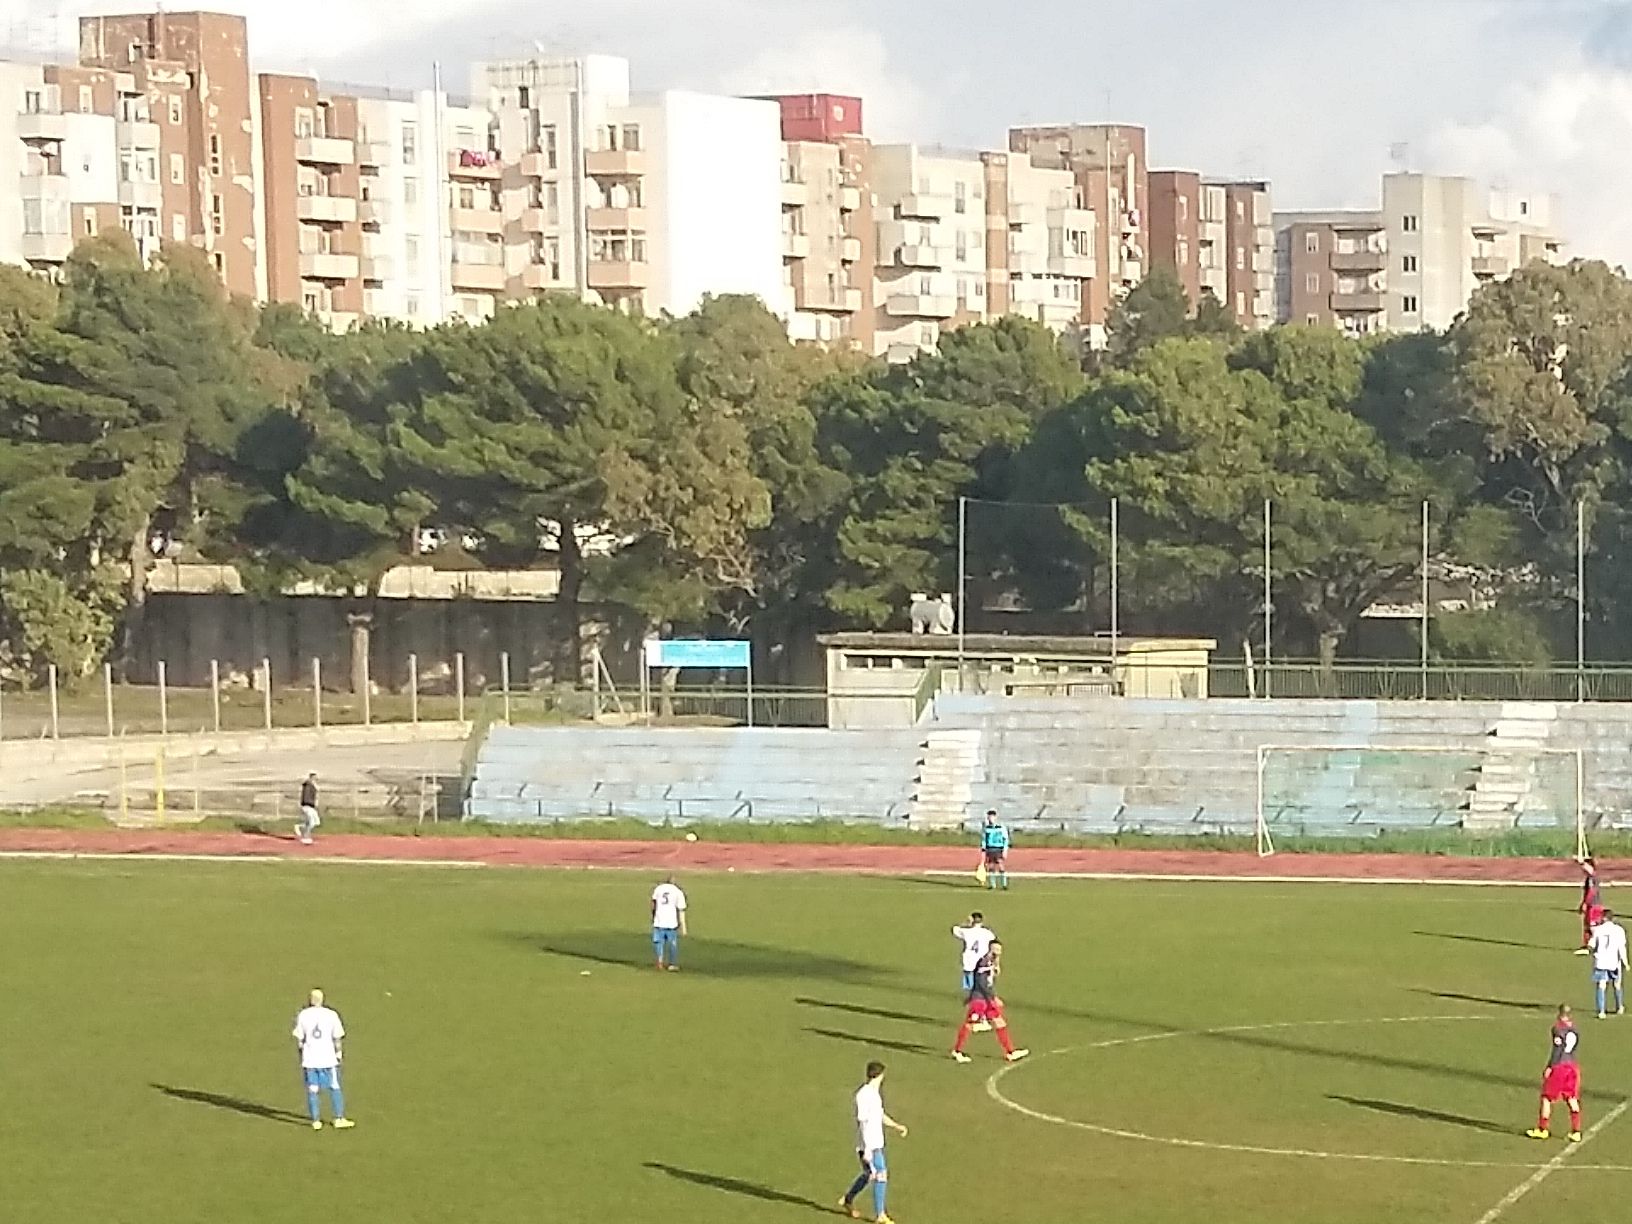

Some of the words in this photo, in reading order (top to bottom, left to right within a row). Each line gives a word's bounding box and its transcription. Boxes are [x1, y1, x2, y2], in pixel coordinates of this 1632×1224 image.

[661, 891, 671, 905] 5
[970, 939, 980, 954] 4
[312, 1023, 323, 1040] 6
